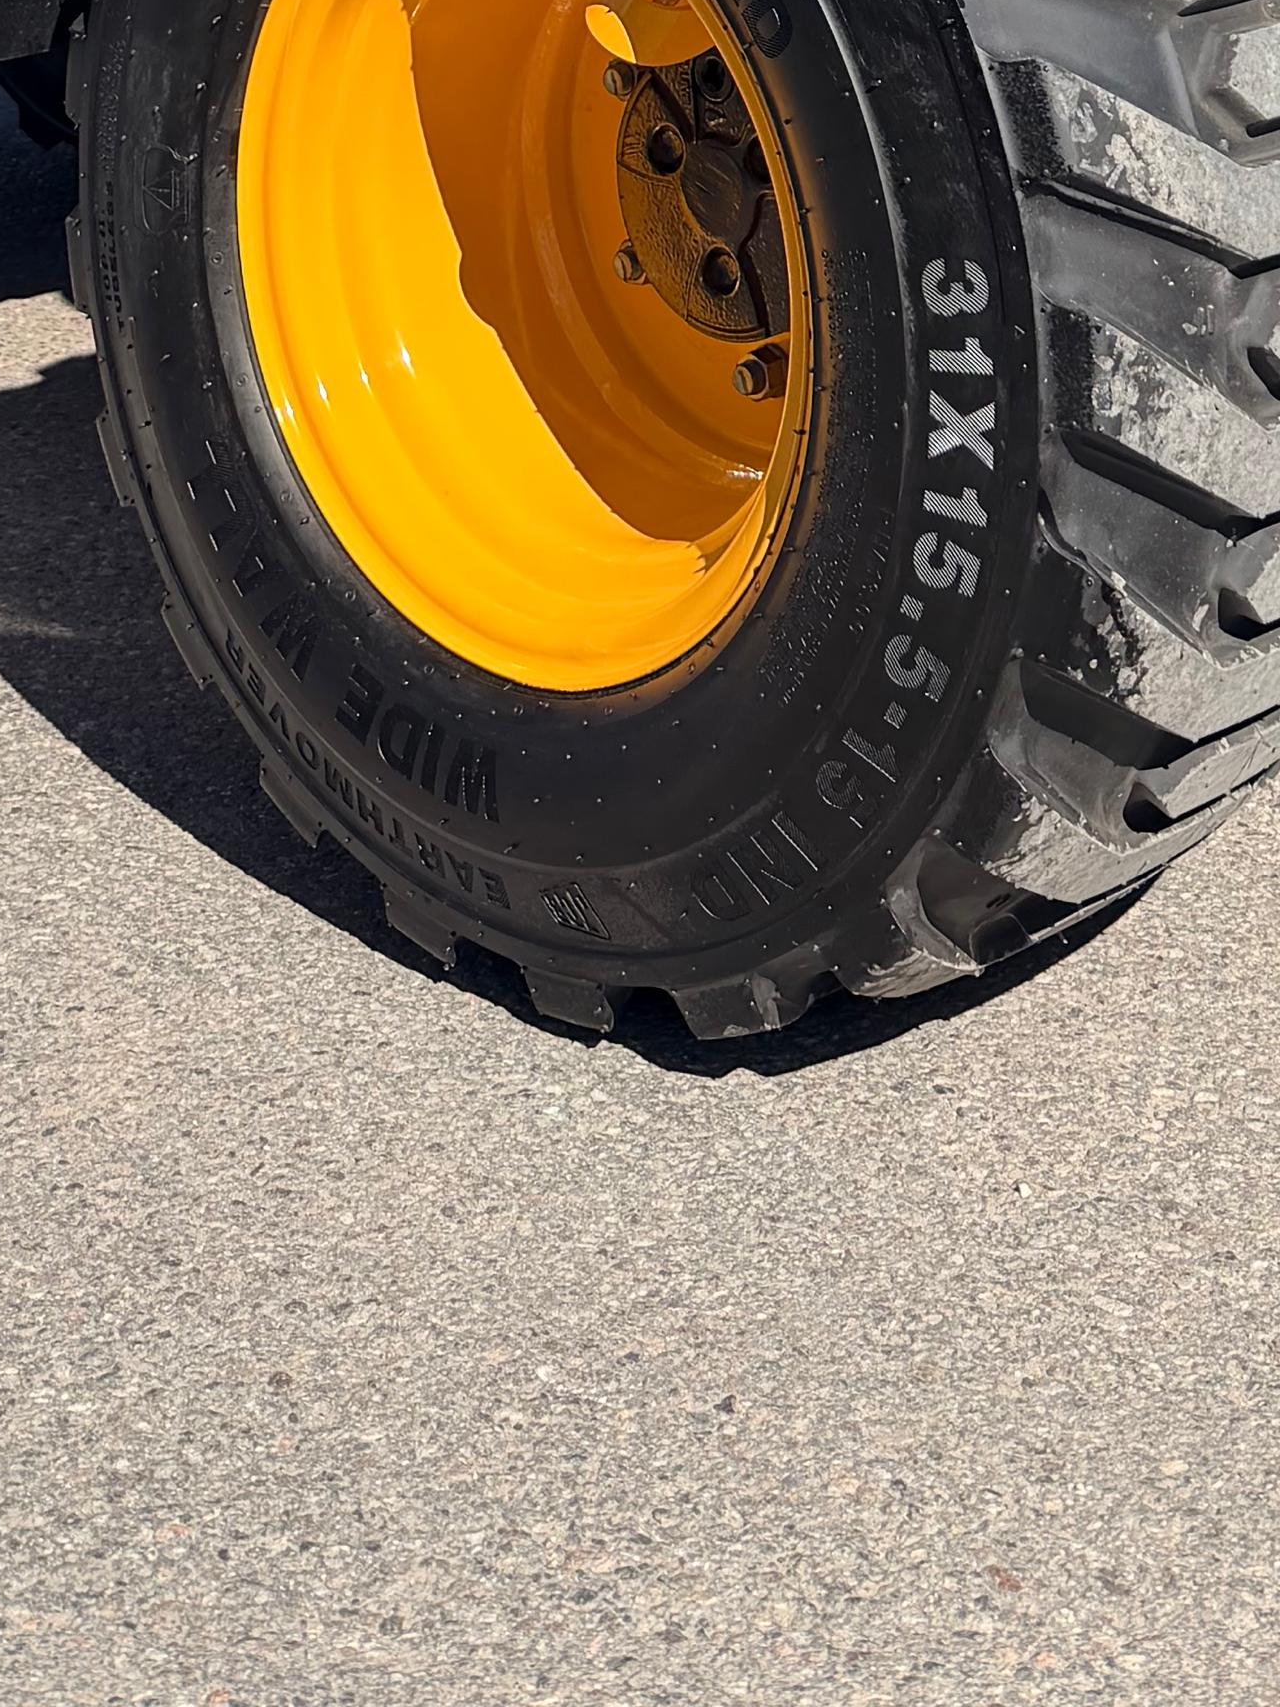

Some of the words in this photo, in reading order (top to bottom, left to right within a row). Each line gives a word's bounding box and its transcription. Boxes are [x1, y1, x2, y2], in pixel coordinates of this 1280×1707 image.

[222, 627, 512, 910] EARTHMOVER
[332, 662, 501, 825] WIDE
[690, 809, 820, 922] IND
